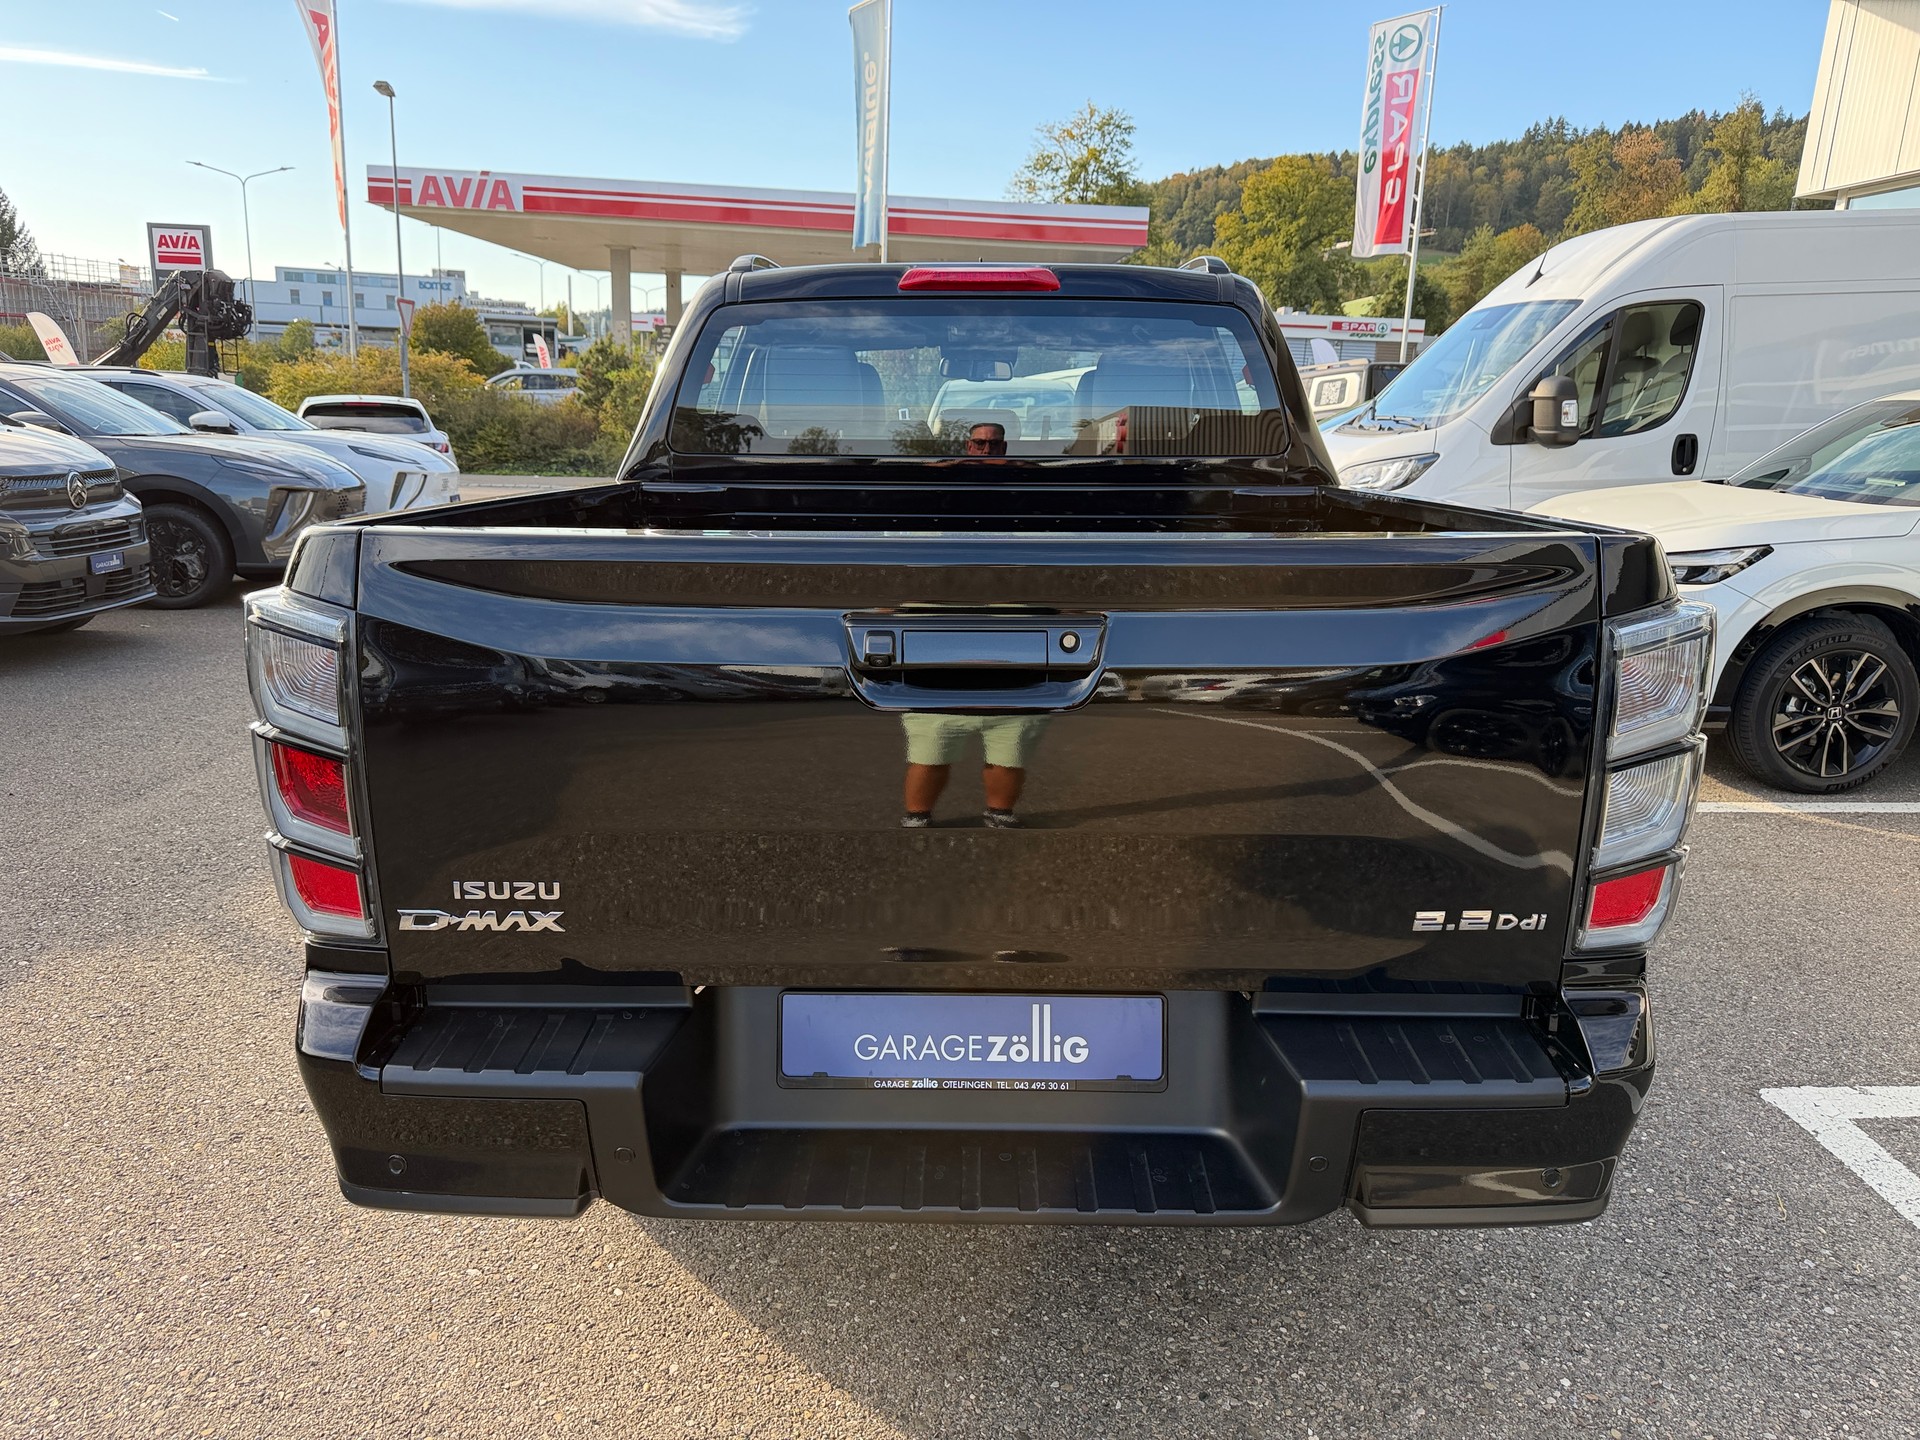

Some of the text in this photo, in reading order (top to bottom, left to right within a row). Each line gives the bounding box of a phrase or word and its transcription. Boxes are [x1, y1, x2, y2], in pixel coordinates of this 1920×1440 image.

[417, 170, 516, 210] AVIA
[157, 232, 200, 249] AVIA
[1341, 322, 1376, 331] SPAR
[1789, 635, 1851, 665] MICHELIN
[452, 881, 561, 900] ISUZU
[397, 909, 566, 932] D-MAX
[1412, 910, 1548, 932] 2.2 Ddi
[854, 1034, 983, 1062] GARAGE
[873, 1080, 910, 1089] GARAGE
[942, 1081, 993, 1090] OTELFINGEN
[1014, 1081, 1029, 1090] 043
[1031, 1081, 1046, 1090] 495
[1048, 1081, 1059, 1090] 30
[1060, 1081, 1070, 1090] 61
